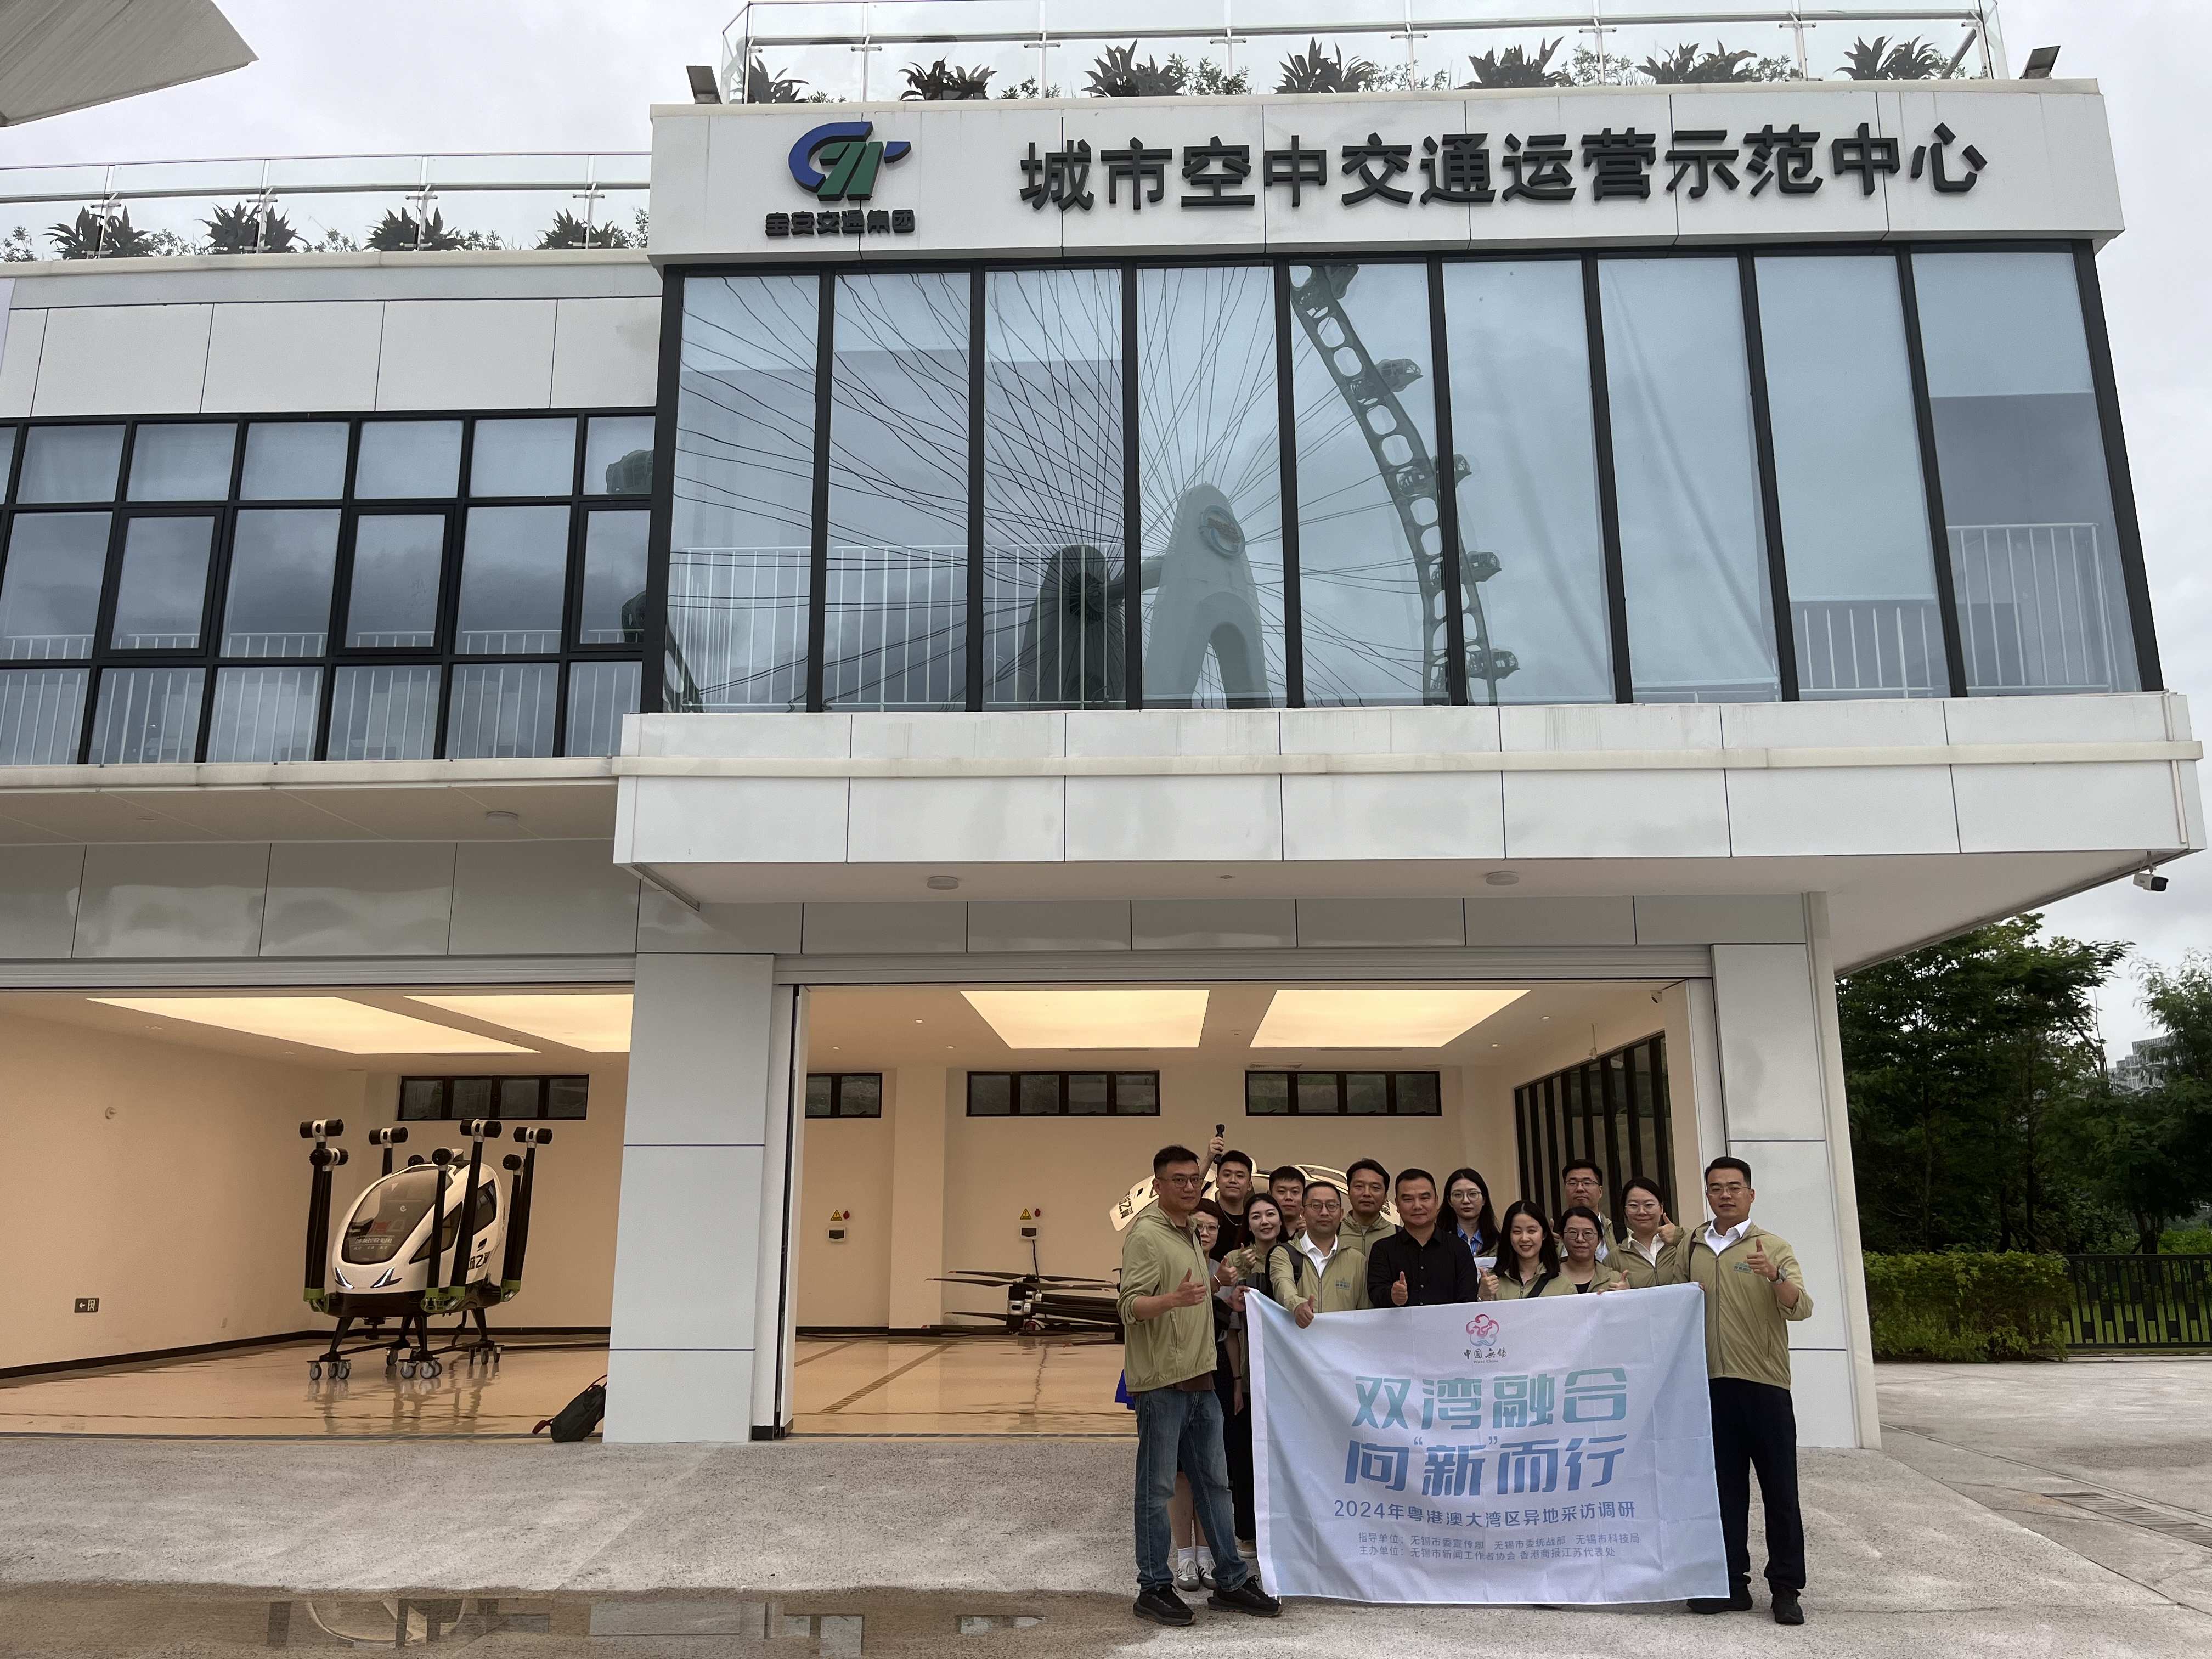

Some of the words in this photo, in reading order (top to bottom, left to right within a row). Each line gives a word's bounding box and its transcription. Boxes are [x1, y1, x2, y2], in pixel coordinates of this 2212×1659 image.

[1019, 121, 1988, 212] 城市空中交通运营示范中心
[765, 209, 916, 236] 宝安交通集团
[1351, 1368, 1627, 1430] 双湾融合
[1334, 1500, 1635, 1528] 2024年粤港澳大湾区异地采访调研
[1576, 1533, 1640, 1545] 无锡市科技局
